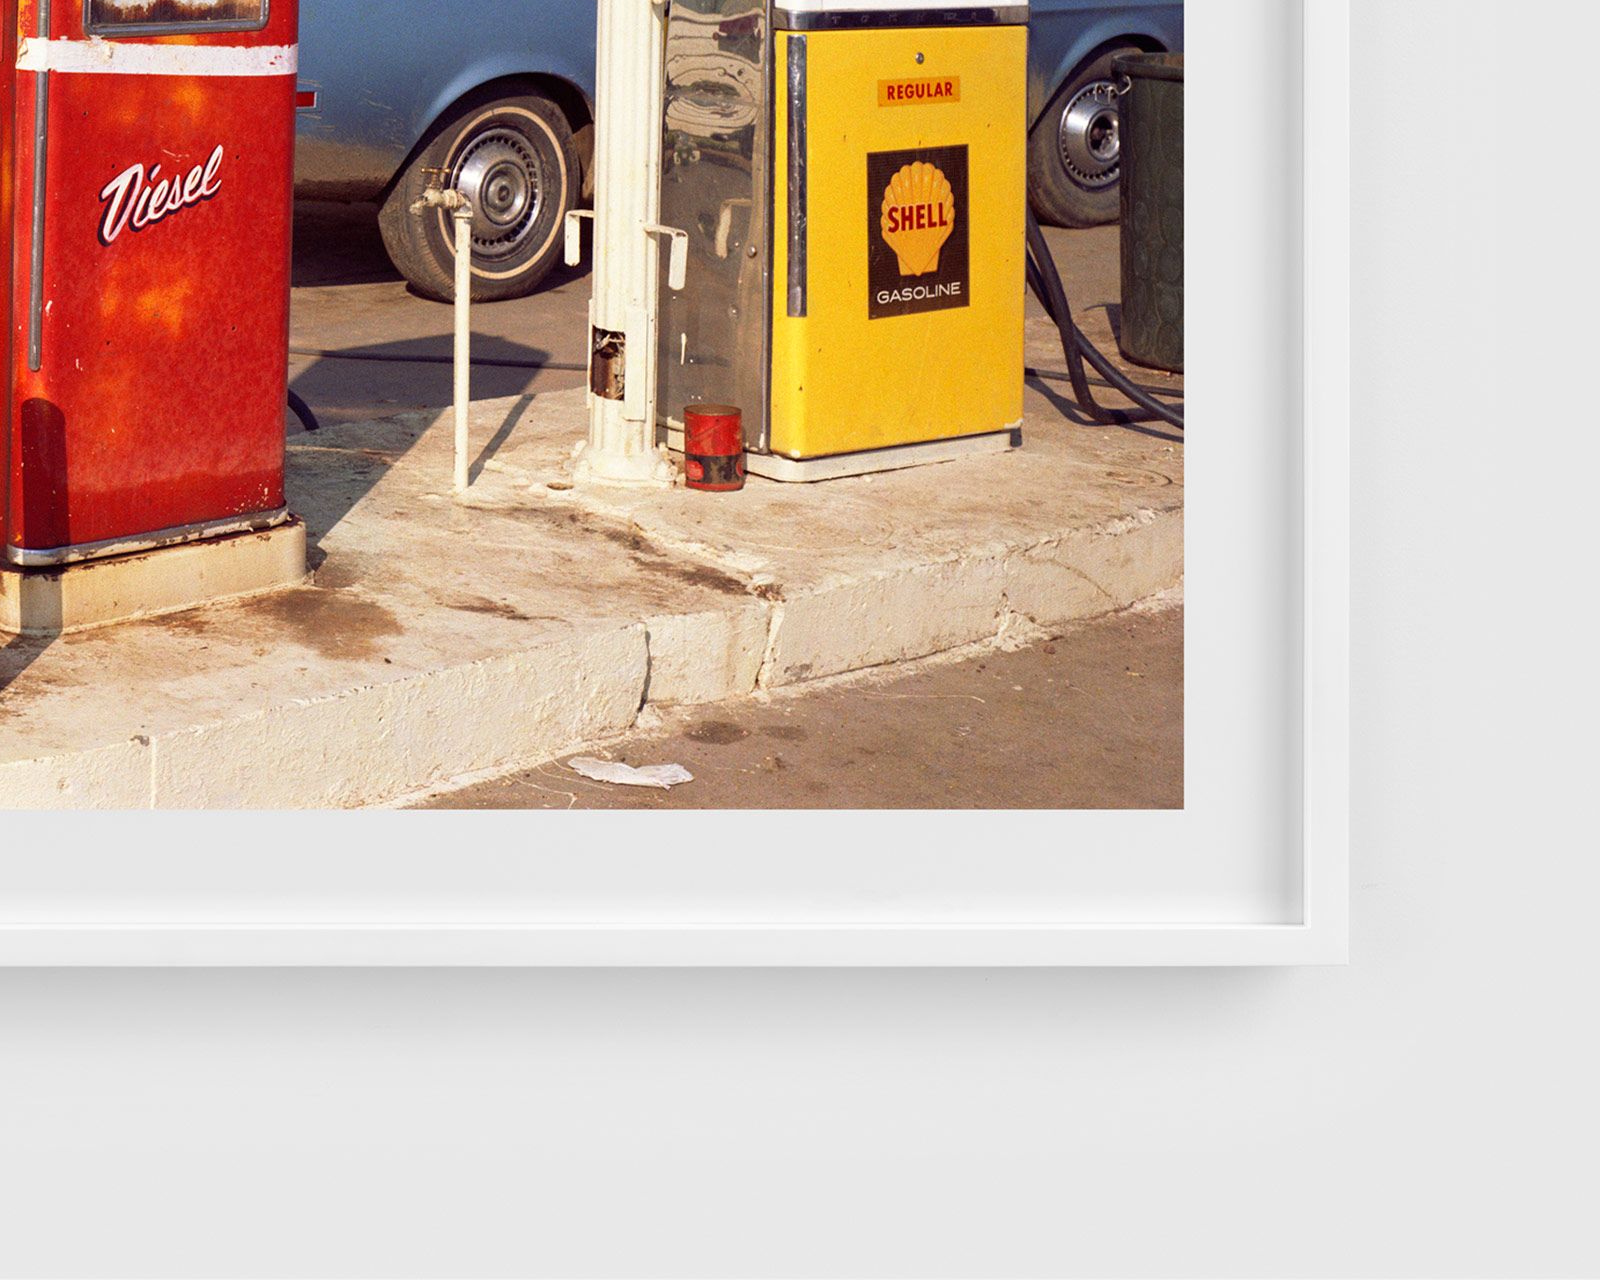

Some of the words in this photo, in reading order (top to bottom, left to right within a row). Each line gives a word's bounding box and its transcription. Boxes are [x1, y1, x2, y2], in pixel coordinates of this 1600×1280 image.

[887, 81, 953, 101] REGULAR
[98, 144, 224, 246] Diesel
[887, 202, 948, 234] SHELL
[877, 282, 961, 305] GASOLINE
